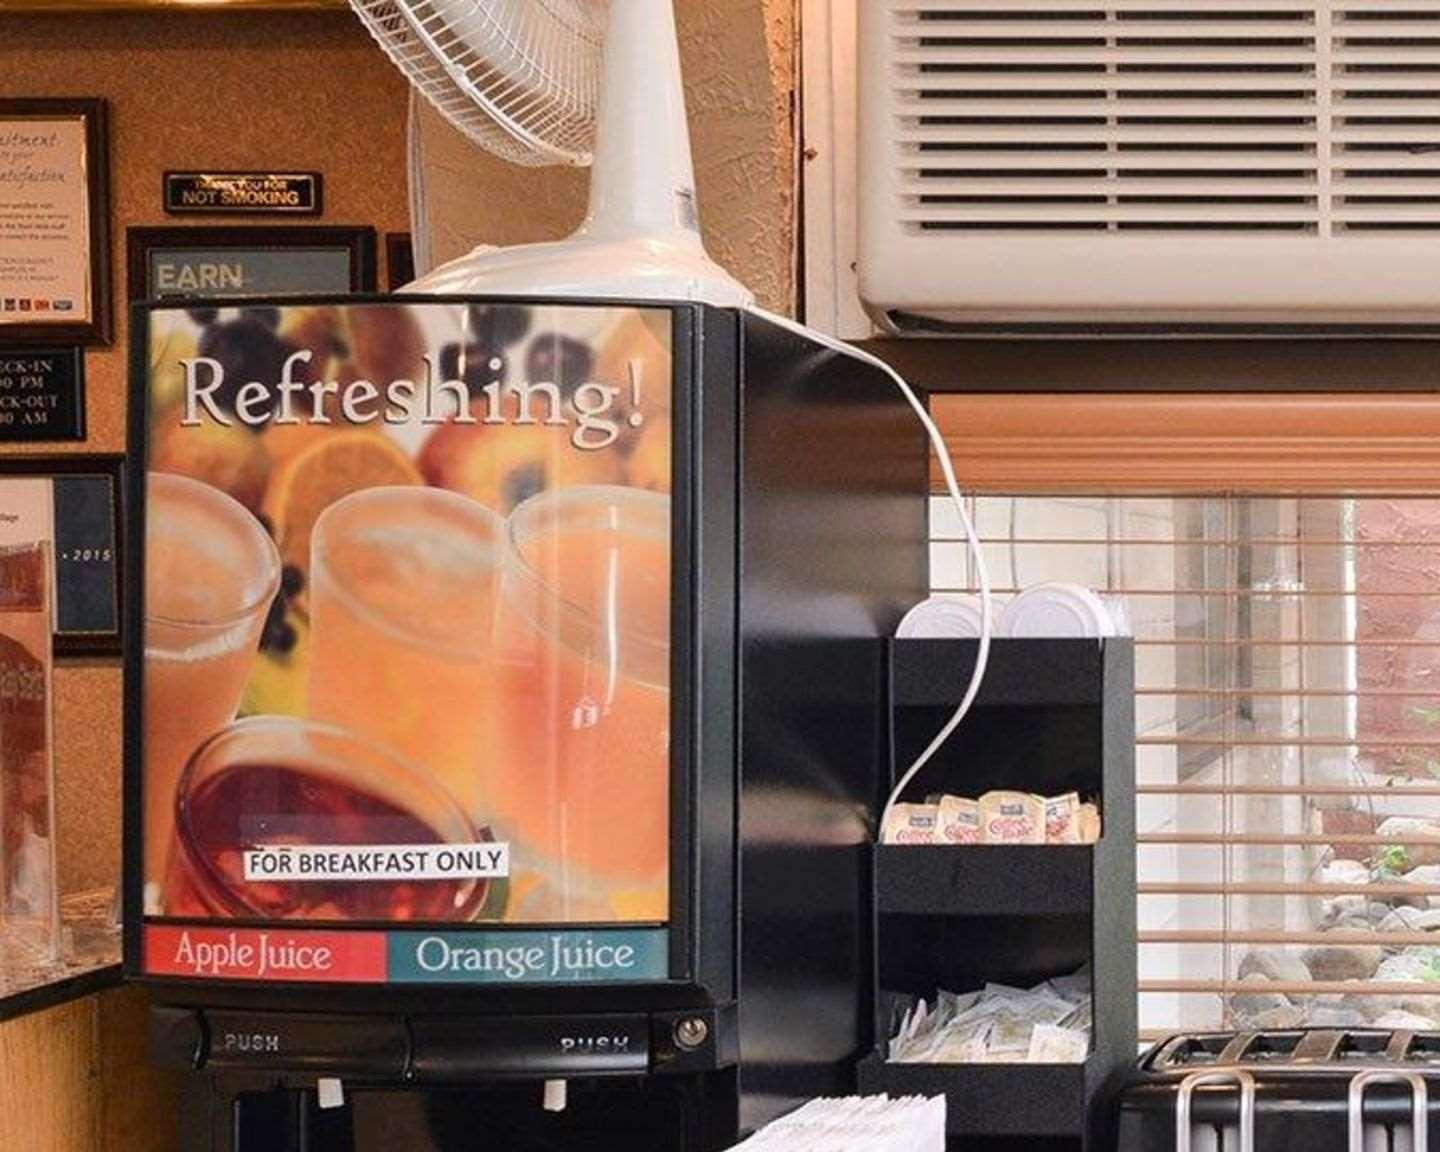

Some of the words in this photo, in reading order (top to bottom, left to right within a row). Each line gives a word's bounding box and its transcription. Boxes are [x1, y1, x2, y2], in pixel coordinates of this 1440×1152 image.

[182, 191, 217, 204] NOT
[221, 190, 299, 205] SMOKING
[157, 264, 243, 289] EARN
[0, 395, 58, 409] CK-OUT
[180, 350, 646, 450] Refreshing!
[73, 549, 112, 561] 2015
[250, 853, 292, 874] FOR
[300, 852, 429, 874] BREAKFAST
[436, 850, 502, 871] ONLY
[174, 931, 253, 974] Apple
[257, 934, 332, 975] Juice
[416, 936, 544, 979] Orange
[551, 936, 635, 976] Juice
[223, 1034, 279, 1051] PUSH
[560, 1036, 629, 1052] PUSH
